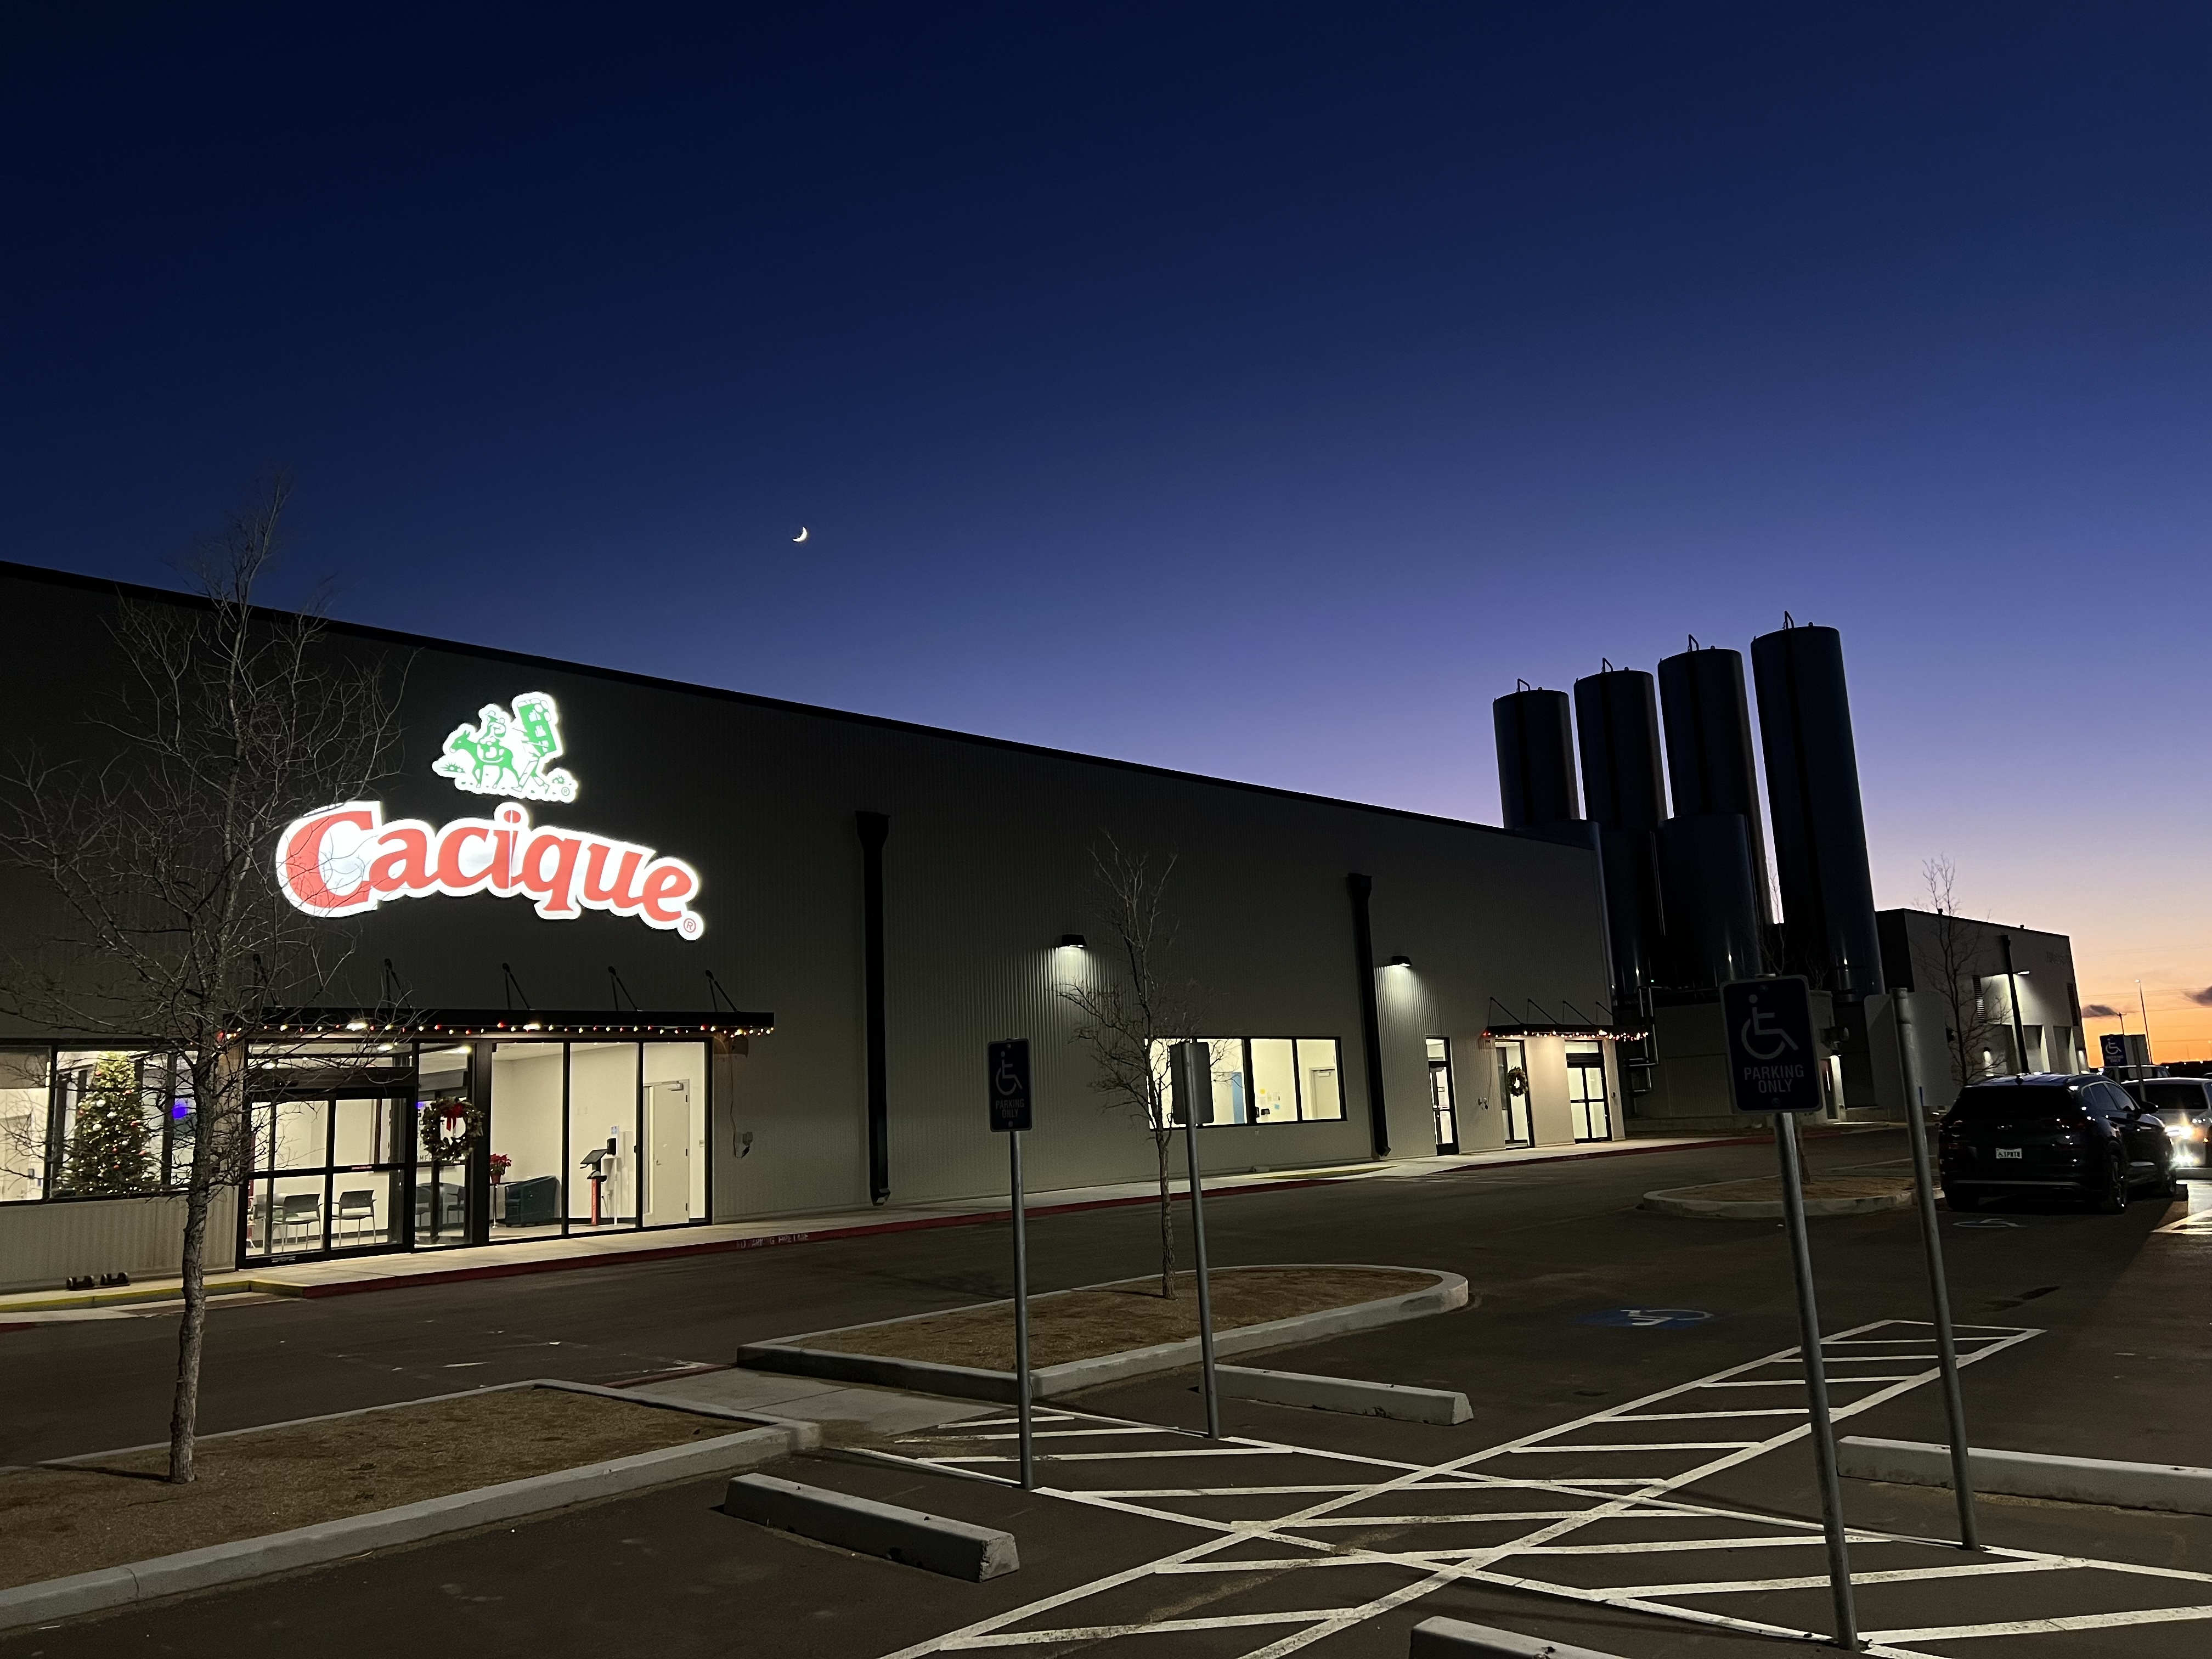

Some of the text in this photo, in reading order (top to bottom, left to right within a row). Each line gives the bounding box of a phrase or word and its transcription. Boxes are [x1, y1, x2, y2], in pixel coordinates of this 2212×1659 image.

[286, 810, 693, 922] Cacique
[1743, 1064, 1804, 1080] PARKING
[1758, 1079, 1793, 1093] ONLY
[995, 1098, 1025, 1110] PARKING
[1002, 1108, 1019, 1118] ONLY
